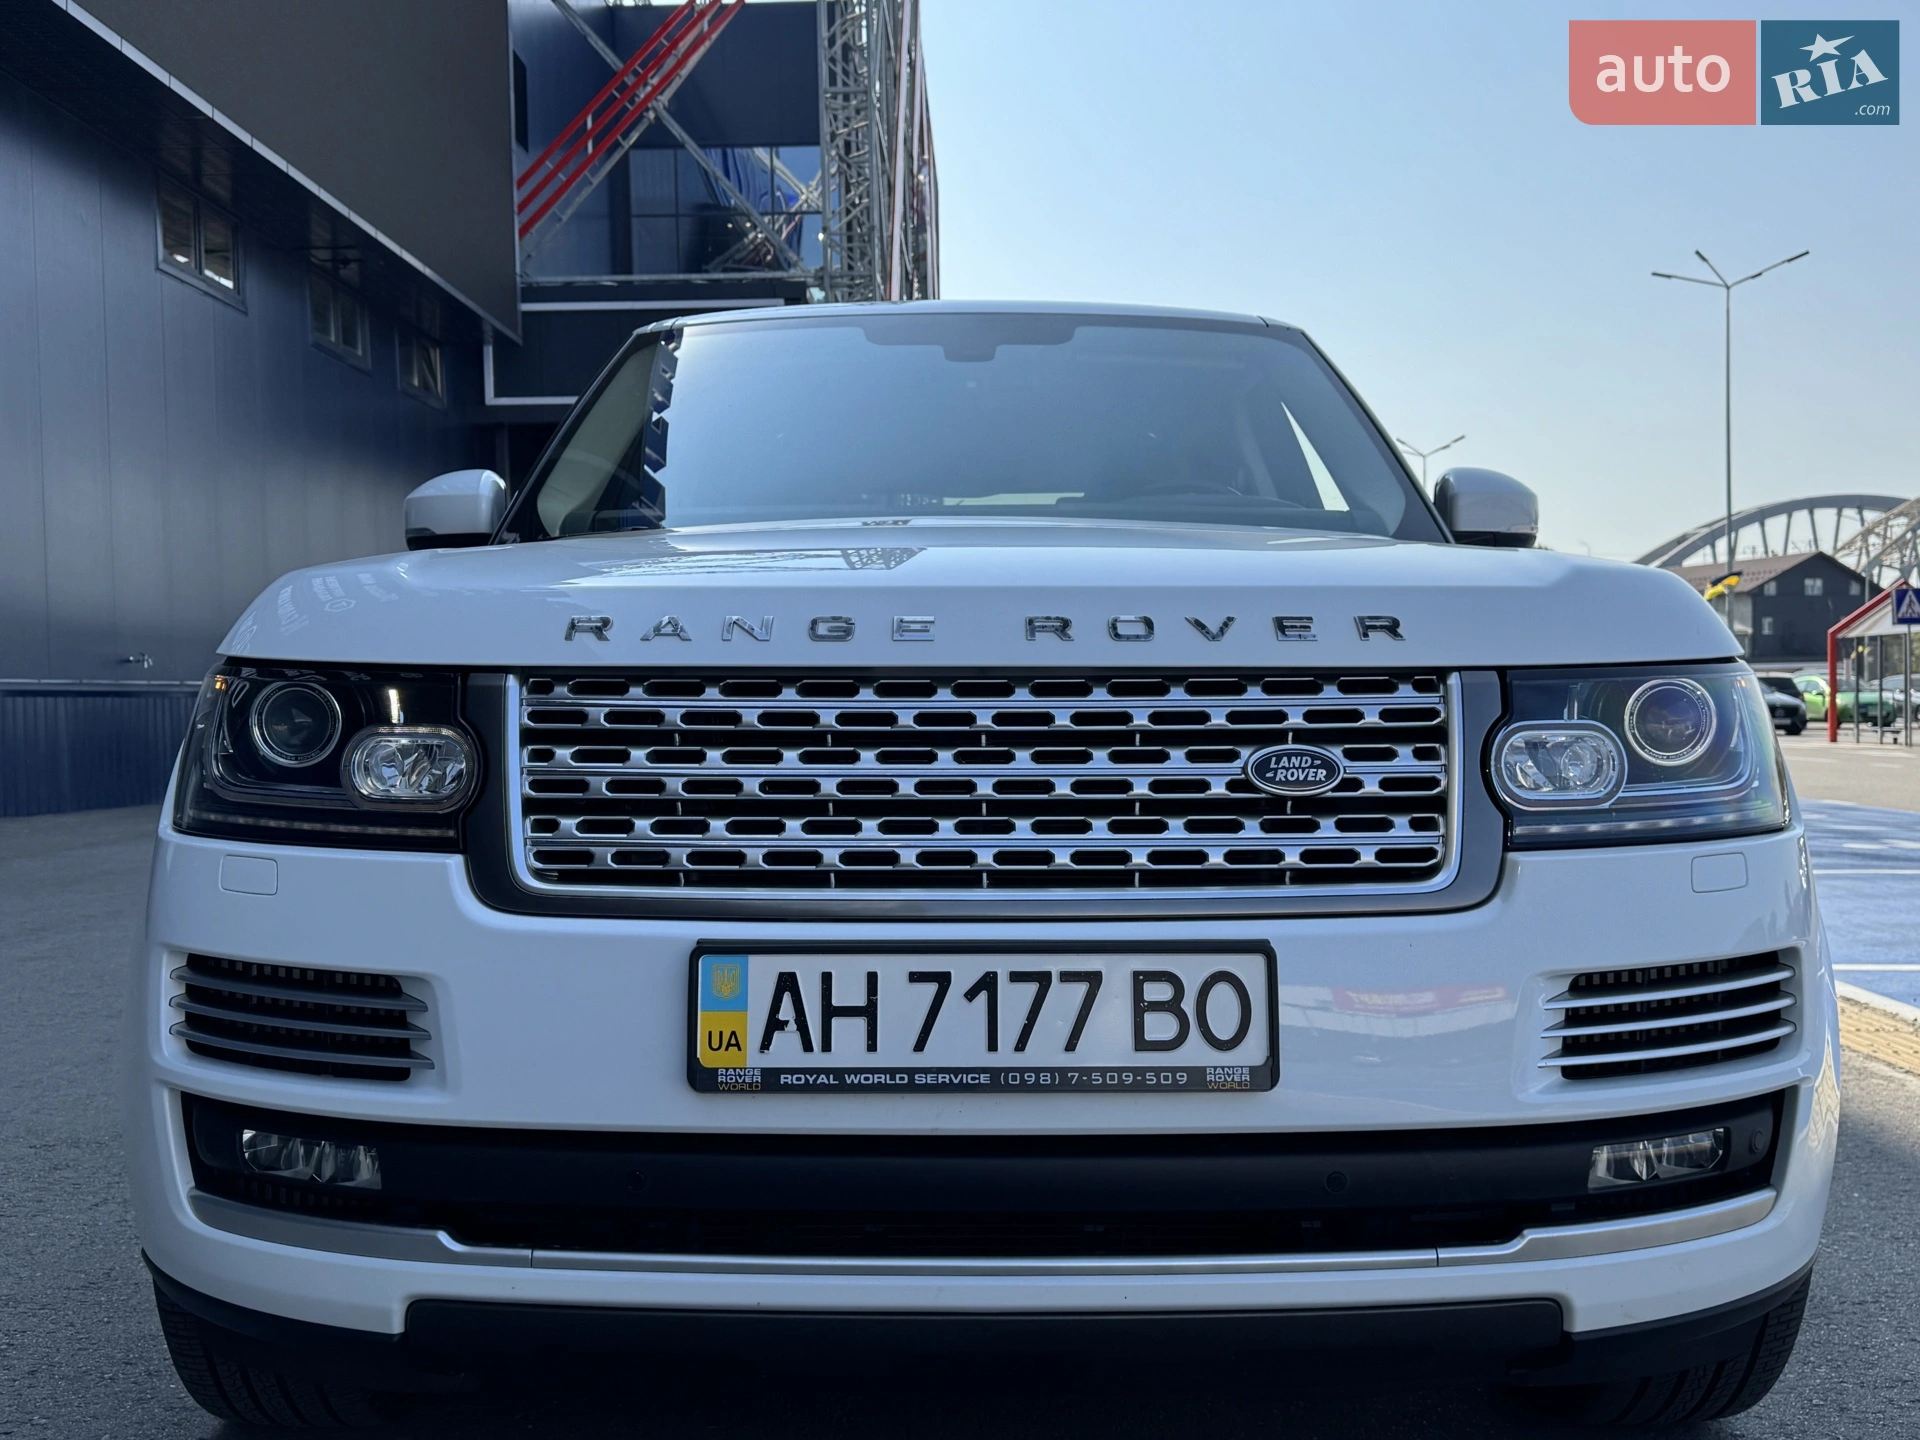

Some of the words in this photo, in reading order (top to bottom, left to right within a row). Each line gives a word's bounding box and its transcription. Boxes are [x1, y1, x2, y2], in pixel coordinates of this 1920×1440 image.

[564, 615, 935, 642] RANGE
[1024, 615, 1406, 642] ROVER
[1270, 756, 1312, 769] LAND
[1275, 768, 1327, 782] ROVER
[759, 970, 879, 1054] AH
[908, 970, 1104, 1053] 7177
[1132, 970, 1253, 1053] BO
[707, 1030, 742, 1052] UA
[718, 1068, 761, 1076] RANGE
[1206, 1067, 1250, 1075] RANGE
[718, 1075, 761, 1083] ROVER
[780, 1074, 839, 1085] ROYAL
[845, 1073, 908, 1084] WORLD
[914, 1073, 991, 1084] SERVICE
[1000, 1072, 1060, 1085] (098)
[1067, 1072, 1188, 1085] 7-509-509
[1206, 1074, 1250, 1082] ROVER
[718, 1083, 761, 1091] WORLD
[1206, 1081, 1250, 1089] WORLD
